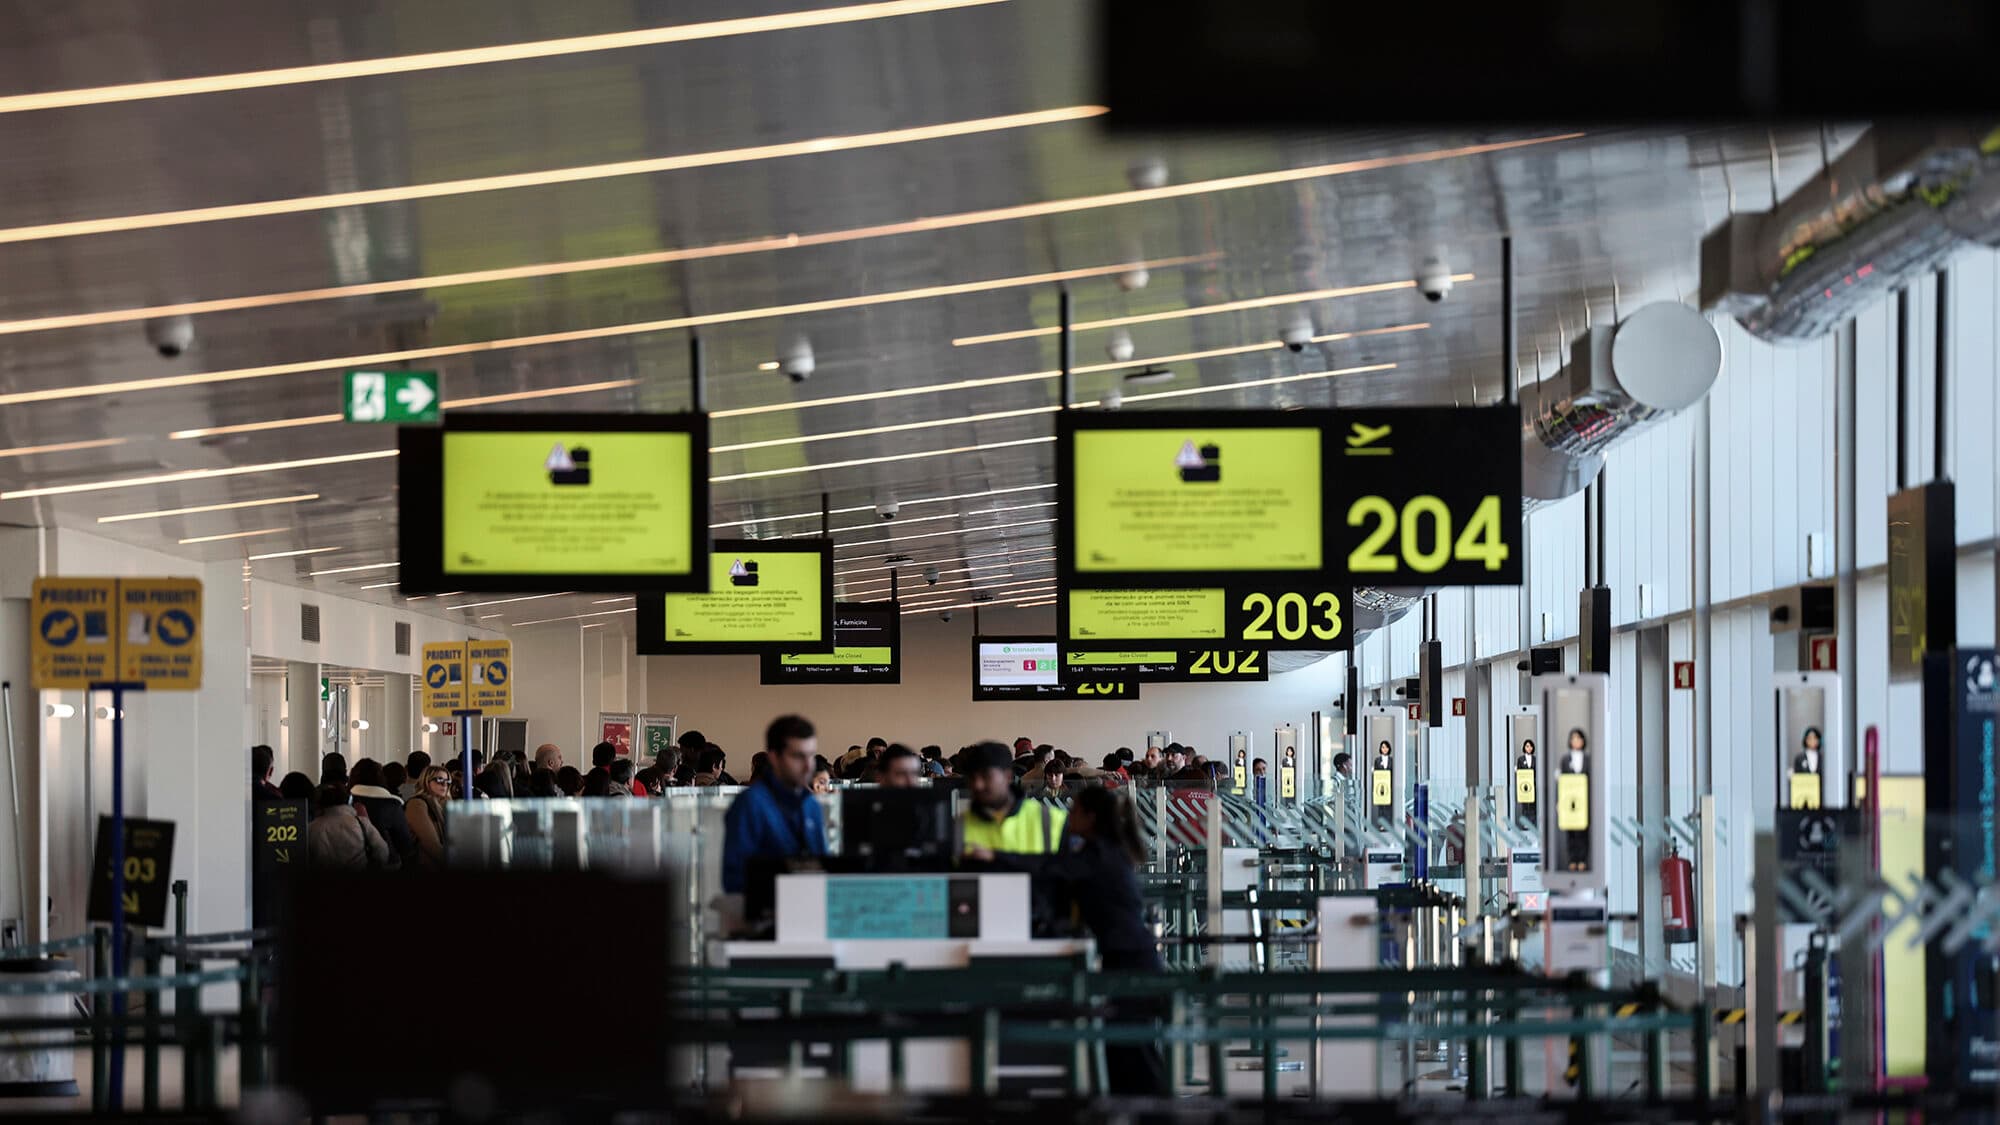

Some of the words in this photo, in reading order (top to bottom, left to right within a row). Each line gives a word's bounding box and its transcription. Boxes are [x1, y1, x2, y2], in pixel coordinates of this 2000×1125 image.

[1347, 495, 1508, 573] 204
[40, 588, 107, 603] PRIORITY
[150, 590, 197, 603] PRIORITY
[1241, 592, 1342, 641] 203
[426, 649, 462, 660] PRIORITY
[483, 647, 508, 658] PRIORITY
[1189, 651, 1260, 674] 202
[615, 734, 622, 746] 1
[653, 731, 660, 741] 2
[652, 743, 660, 753] 3
[267, 826, 297, 842] 202
